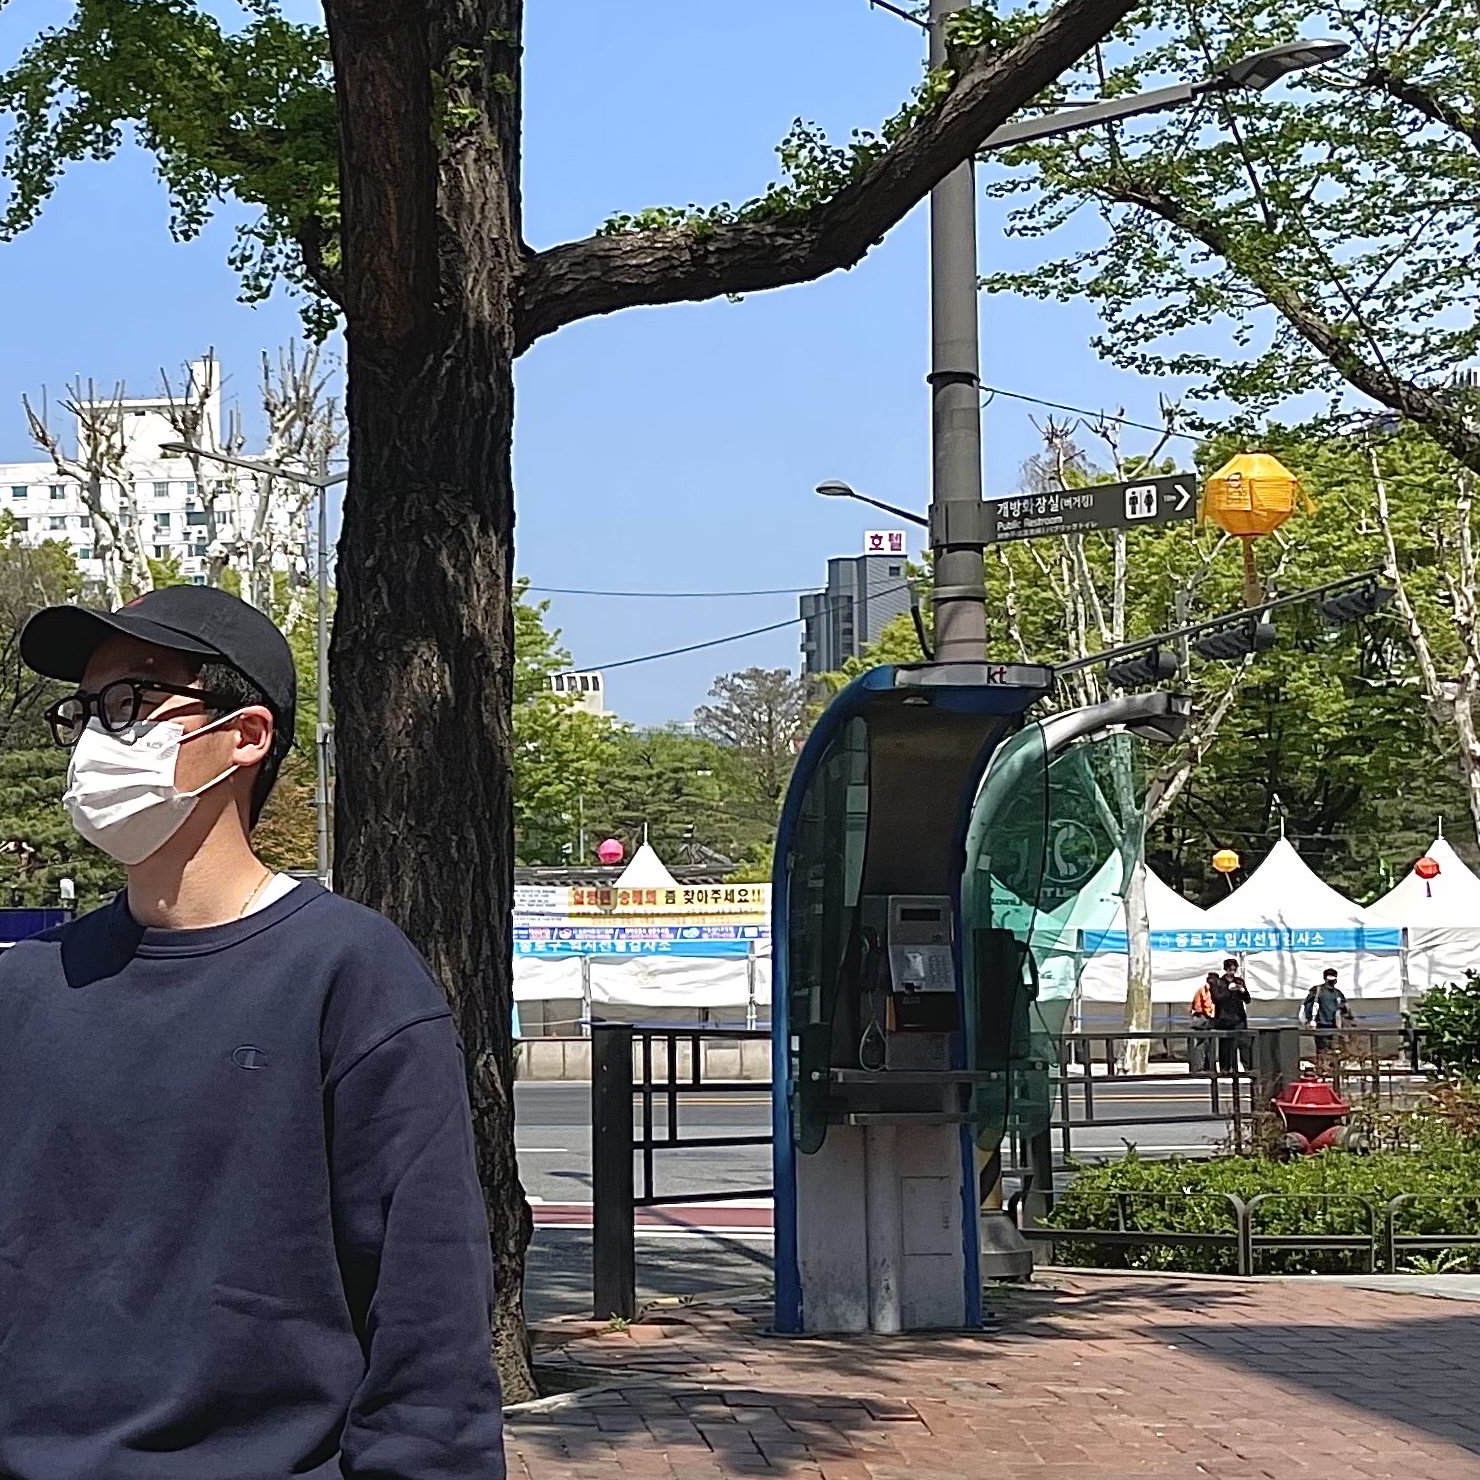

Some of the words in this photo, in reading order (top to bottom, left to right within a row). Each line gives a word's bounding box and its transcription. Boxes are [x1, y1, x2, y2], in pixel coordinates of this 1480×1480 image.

[996, 519, 1021, 532] Public
[1023, 516, 1063, 528] Restroom
[868, 532, 903, 552] 호텔
[986, 665, 1008, 684] kt
[683, 888, 761, 905] 찾아주세요!!
[1175, 931, 1219, 948] 종로구
[1223, 930, 1326, 948] 임시선별검사소
